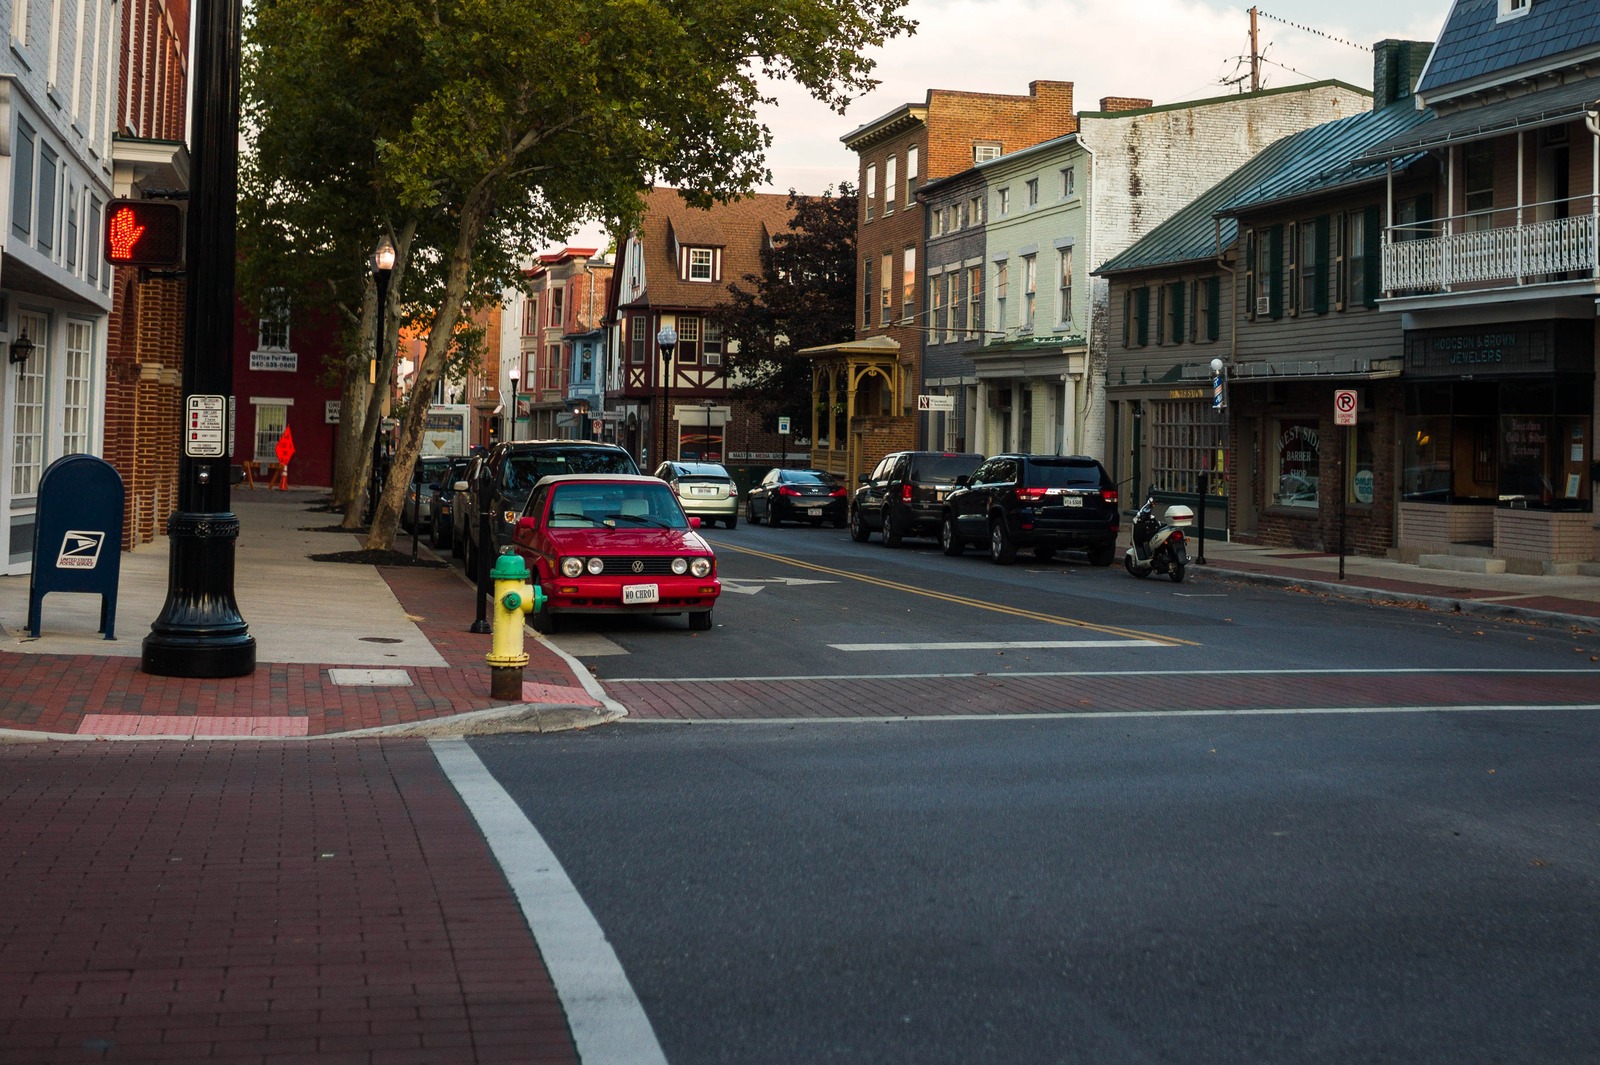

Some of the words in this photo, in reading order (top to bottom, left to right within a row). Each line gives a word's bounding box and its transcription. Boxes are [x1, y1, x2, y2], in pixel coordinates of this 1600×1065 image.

[1483, 333, 1516, 347] BROWN
[1450, 349, 1502, 364] JEWELERS
[1277, 426, 1300, 453] WEST
[1286, 450, 1311, 461] BARBER
[1290, 468, 1308, 480] SHOP
